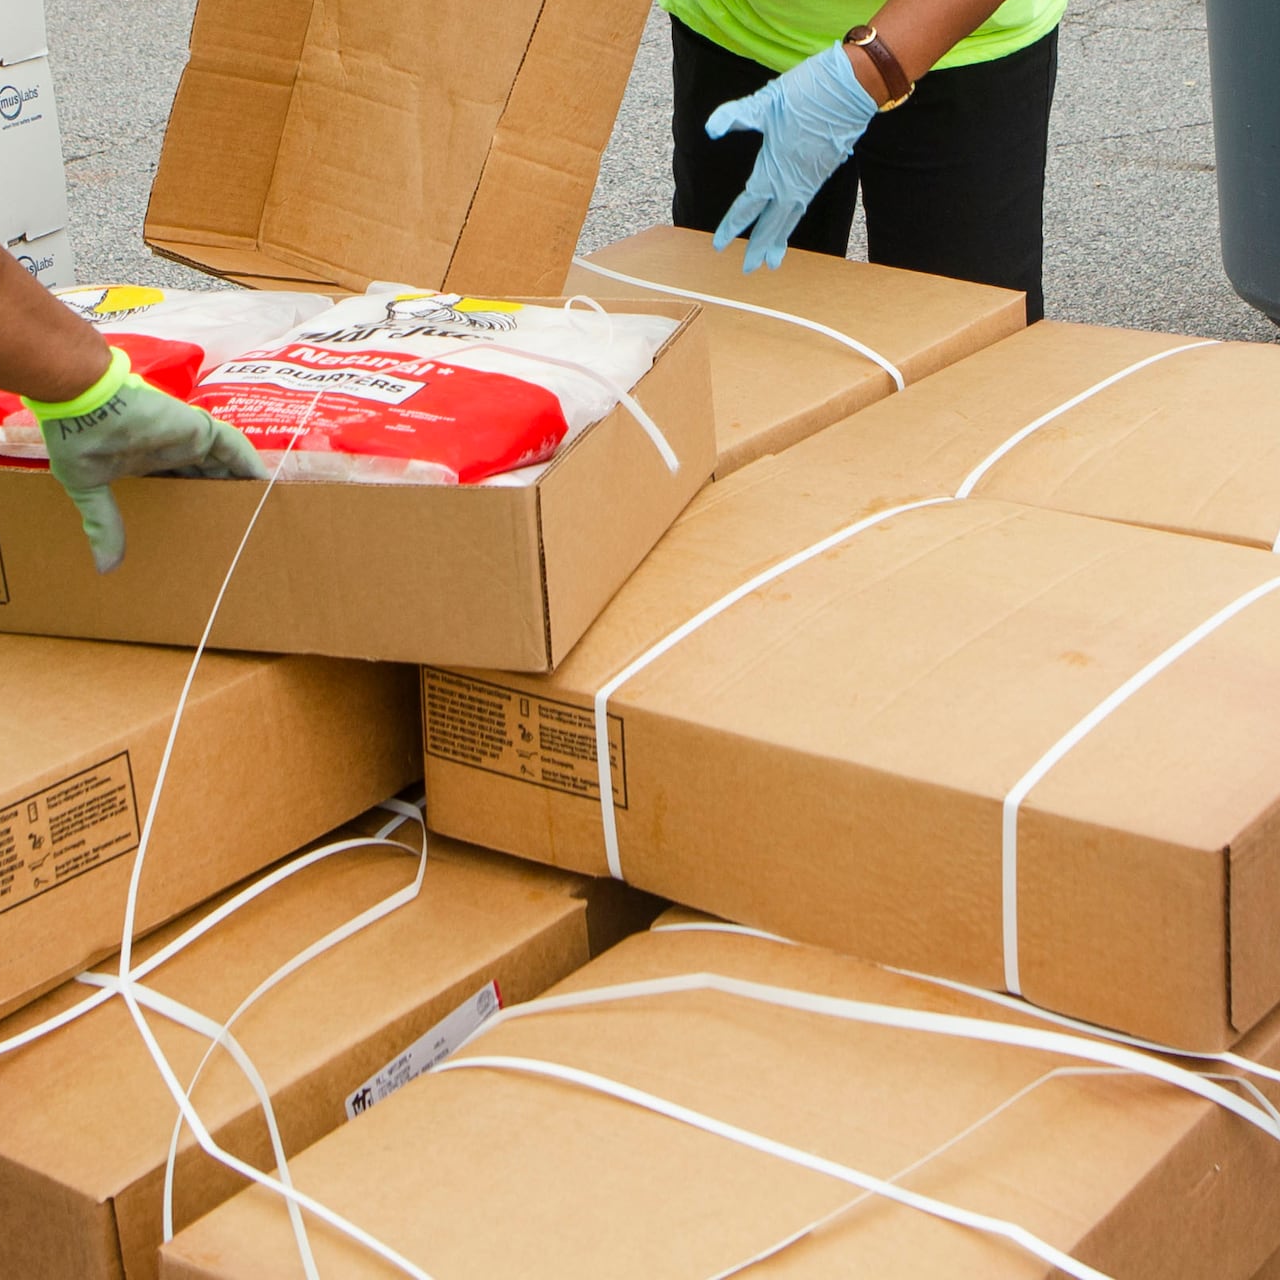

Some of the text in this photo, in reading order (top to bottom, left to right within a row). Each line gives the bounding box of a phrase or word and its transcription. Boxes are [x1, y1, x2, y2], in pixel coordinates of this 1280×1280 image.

[225, 363, 407, 394] LEG QUARTERS
[62, 394, 127, 441] Henry
